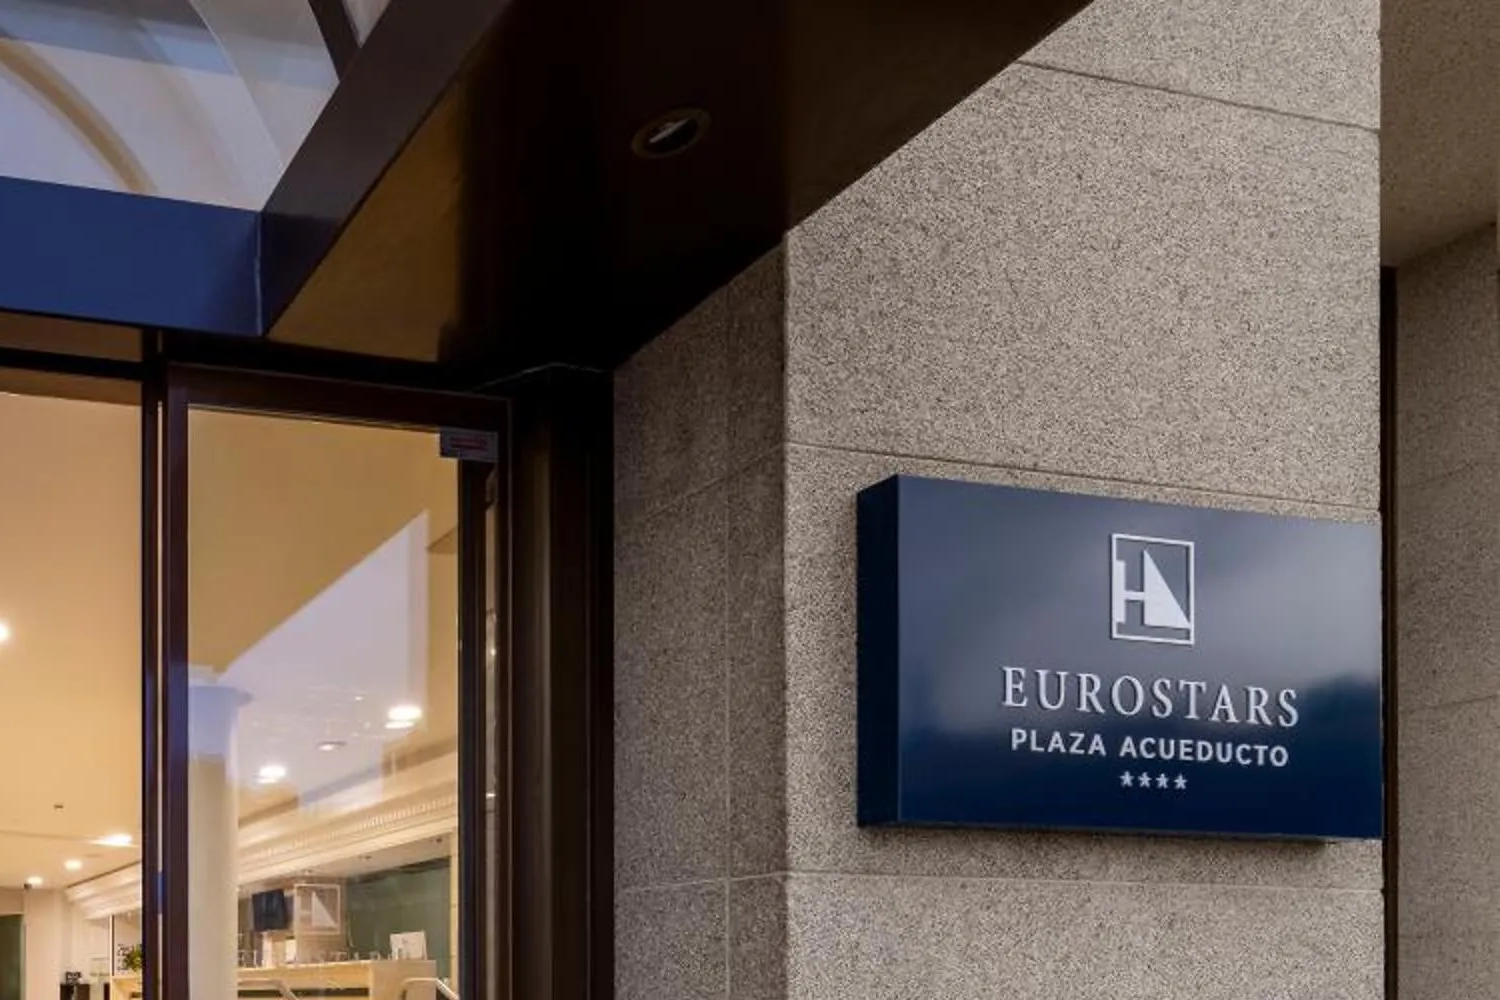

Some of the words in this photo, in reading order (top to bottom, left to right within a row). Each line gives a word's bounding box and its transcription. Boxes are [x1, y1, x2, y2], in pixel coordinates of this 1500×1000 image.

[1002, 666, 1299, 728] EUROSTARS
[1011, 728, 1107, 757] PLAZA
[1118, 735, 1290, 767] ACUEDUCTO
